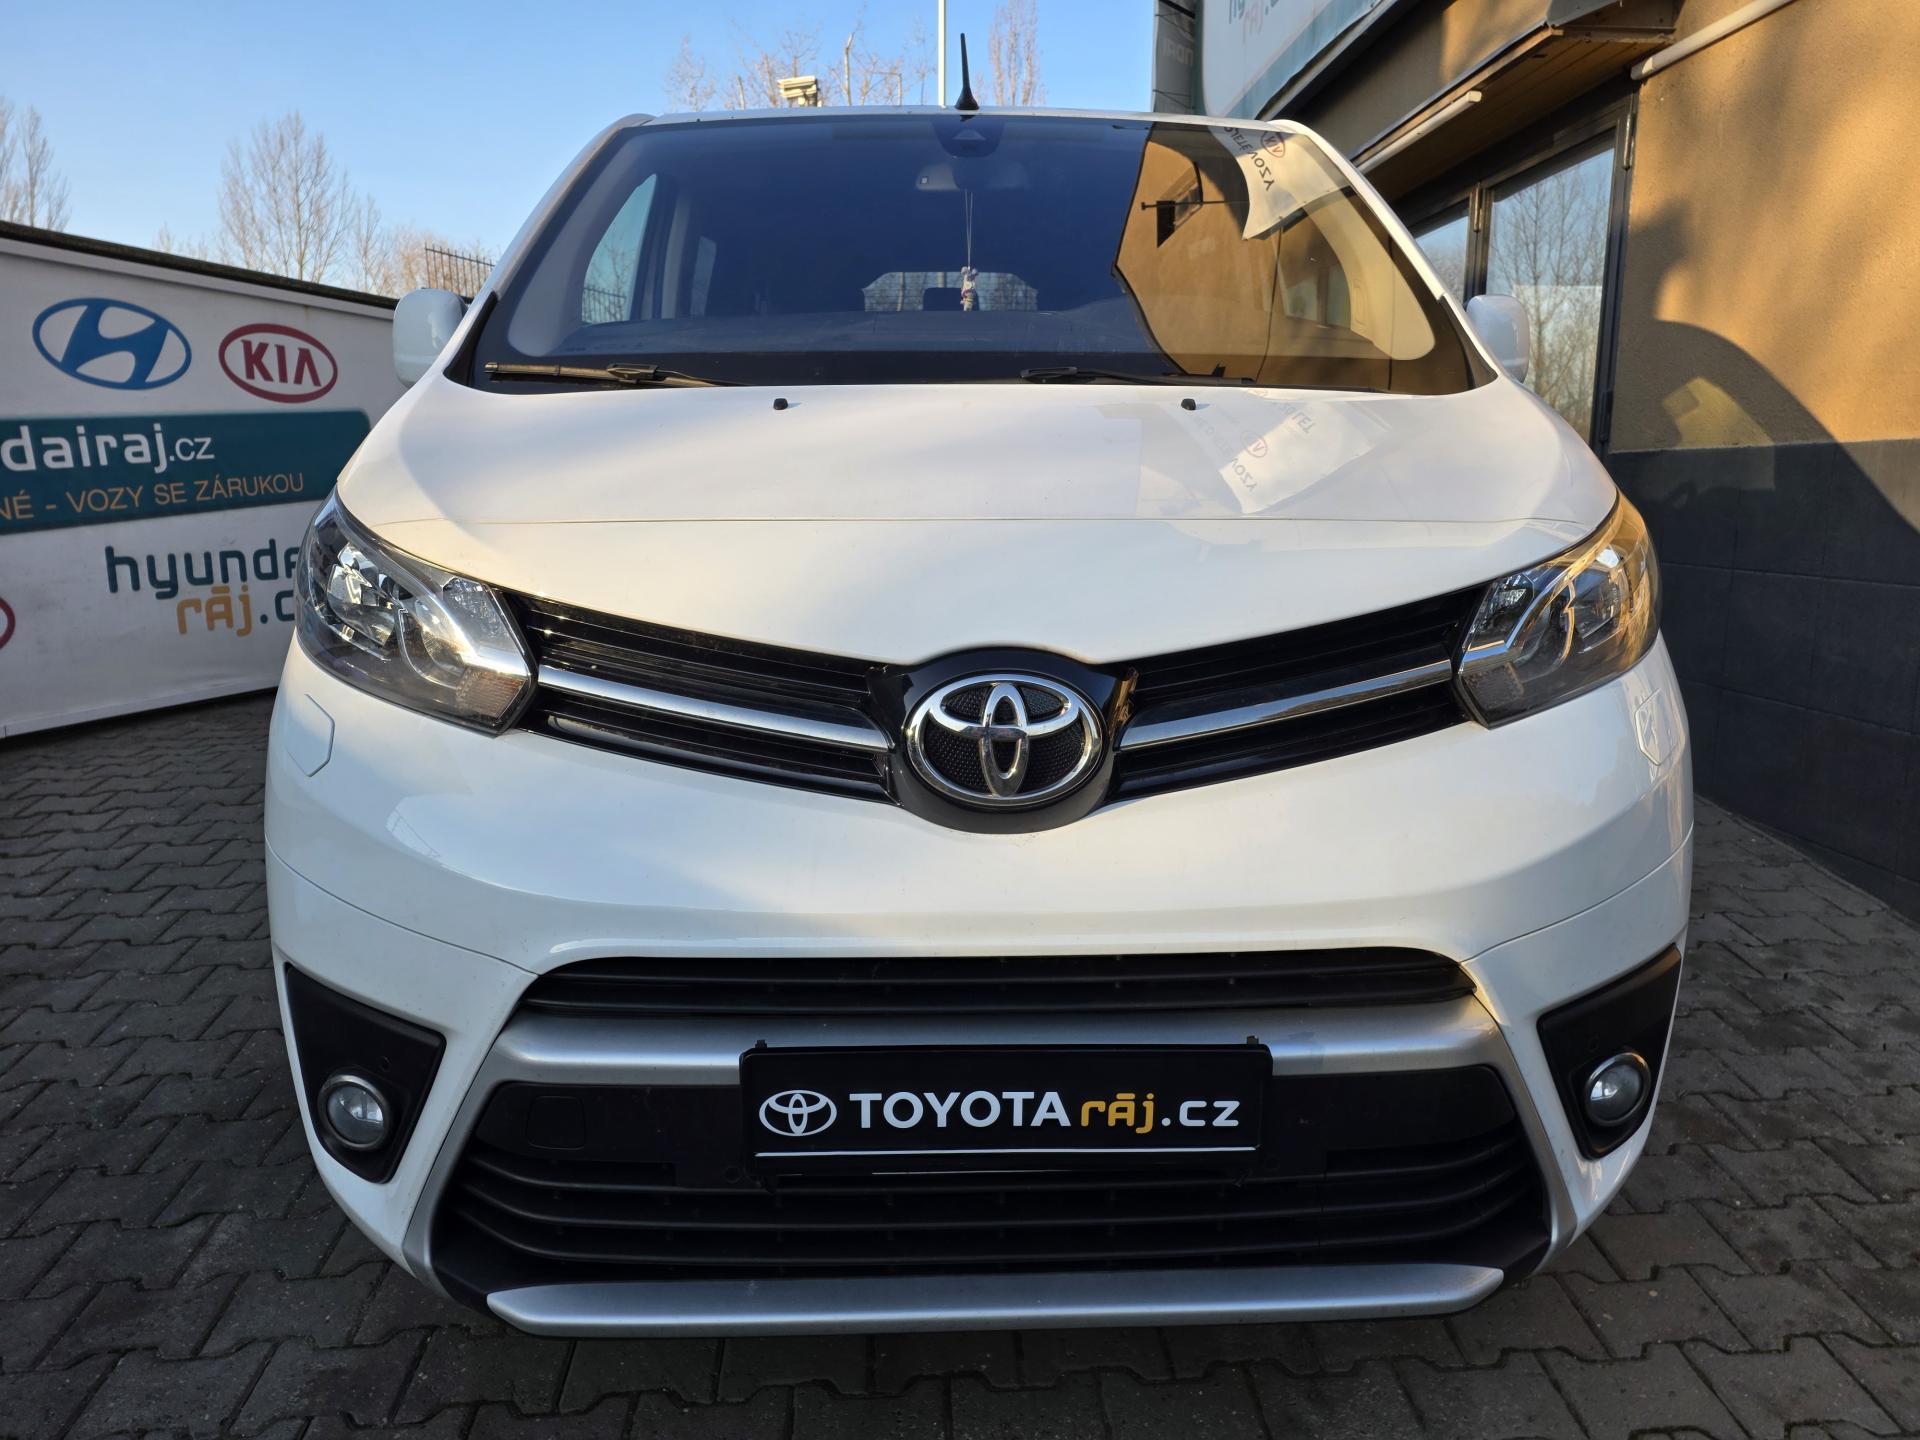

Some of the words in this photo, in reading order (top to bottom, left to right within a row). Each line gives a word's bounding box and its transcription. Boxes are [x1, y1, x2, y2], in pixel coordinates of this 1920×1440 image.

[241, 339, 322, 387] KIA
[66, 485, 144, 514] VOZY
[153, 482, 188, 505] SE
[194, 473, 305, 501] ZÁRUKOU
[849, 1090, 1071, 1129] TOYOTA
